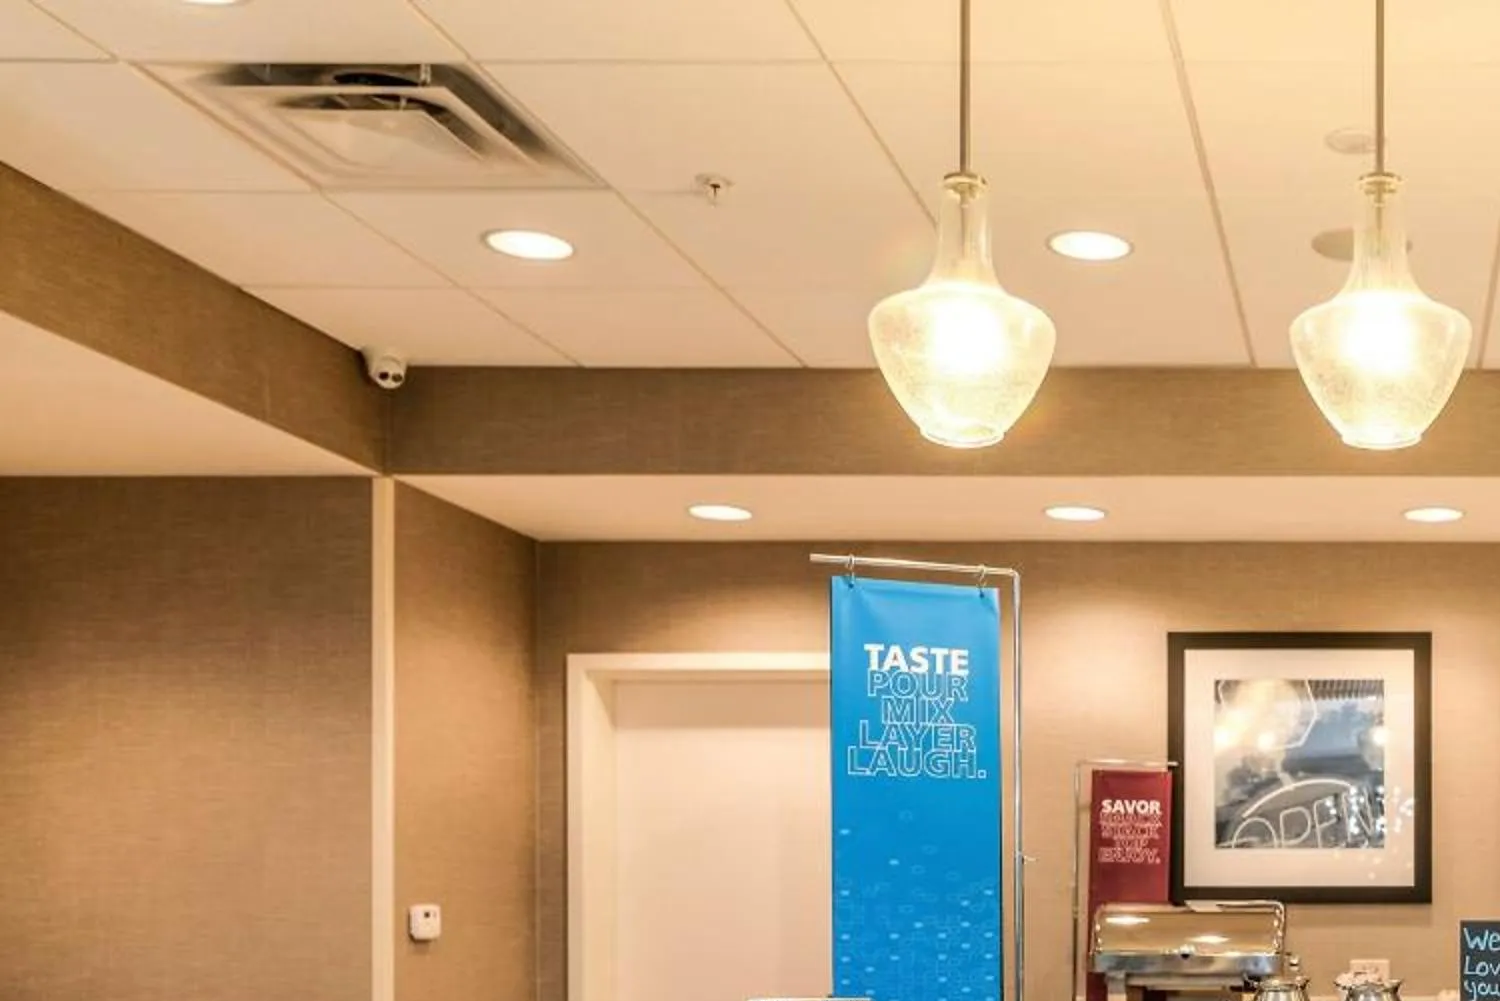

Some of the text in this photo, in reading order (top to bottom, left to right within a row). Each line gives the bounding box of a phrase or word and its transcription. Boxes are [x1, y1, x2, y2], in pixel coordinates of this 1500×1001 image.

[864, 643, 969, 676] TASTE
[867, 668, 969, 702] POUR
[881, 695, 954, 725] MIX
[859, 720, 977, 752] LAYER
[847, 746, 987, 779] LAUGH.
[1101, 799, 1162, 814] SAVOR
